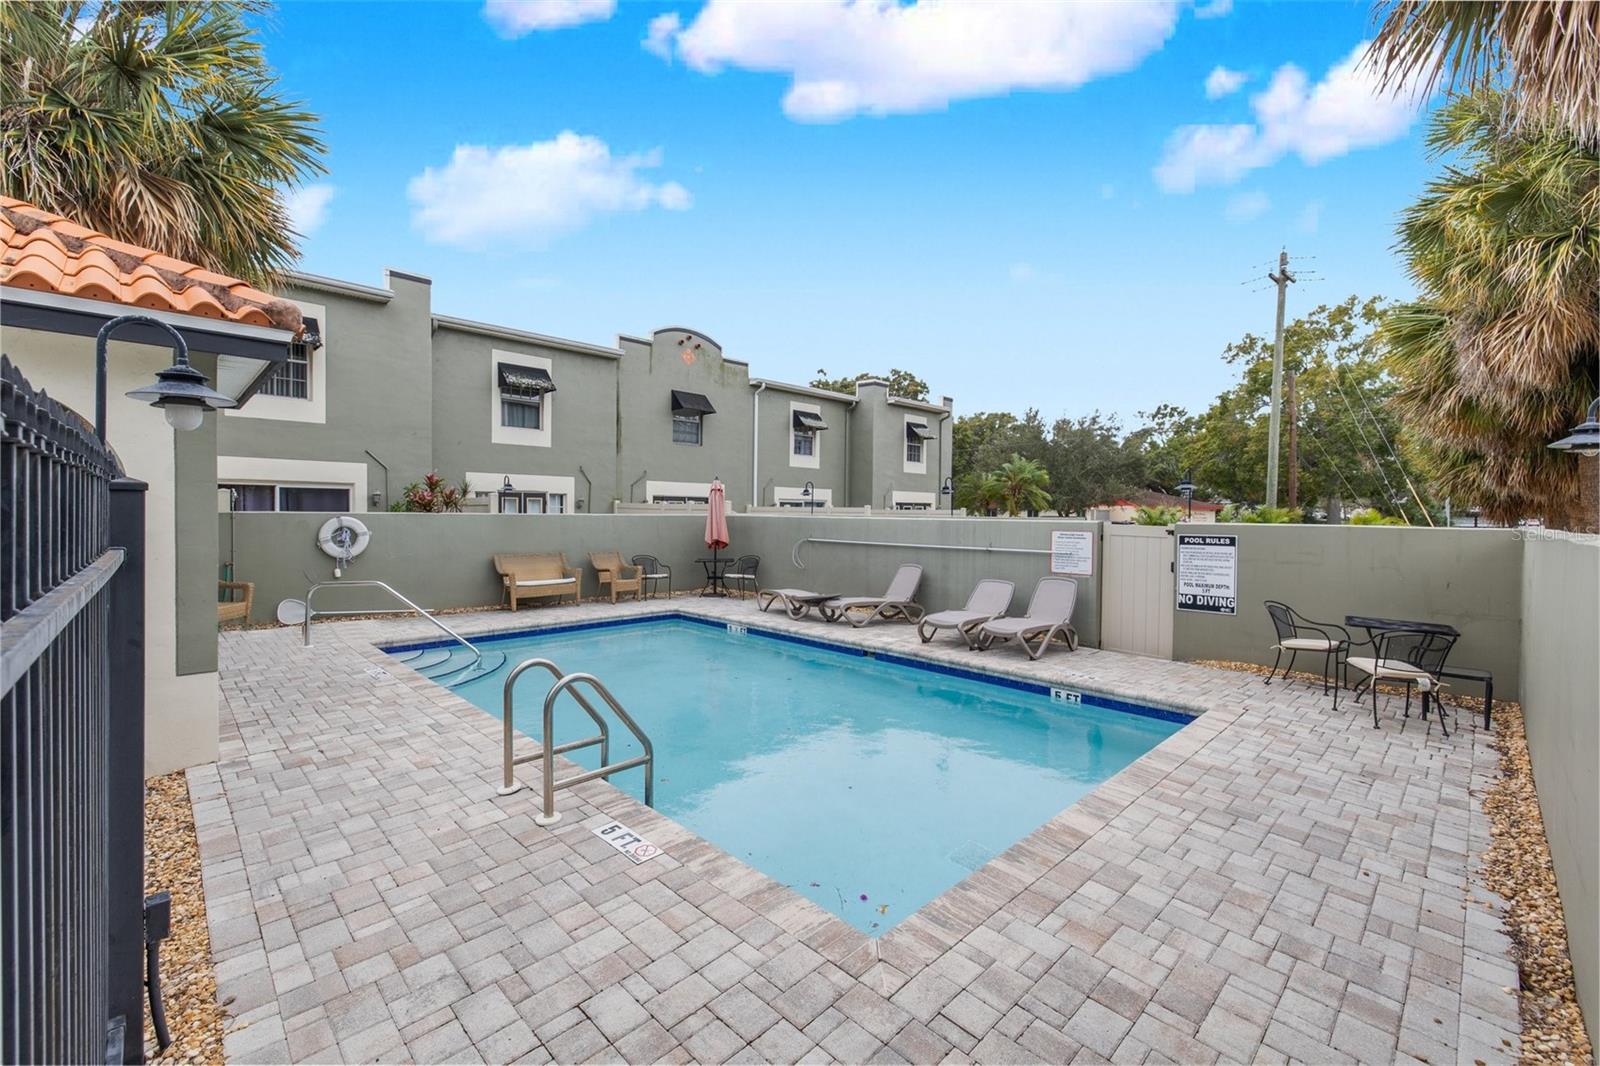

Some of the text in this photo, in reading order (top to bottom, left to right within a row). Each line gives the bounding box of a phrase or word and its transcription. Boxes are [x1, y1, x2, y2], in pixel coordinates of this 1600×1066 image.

[1178, 594, 1235, 608] NO DIVING
[601, 824, 623, 836] 5
